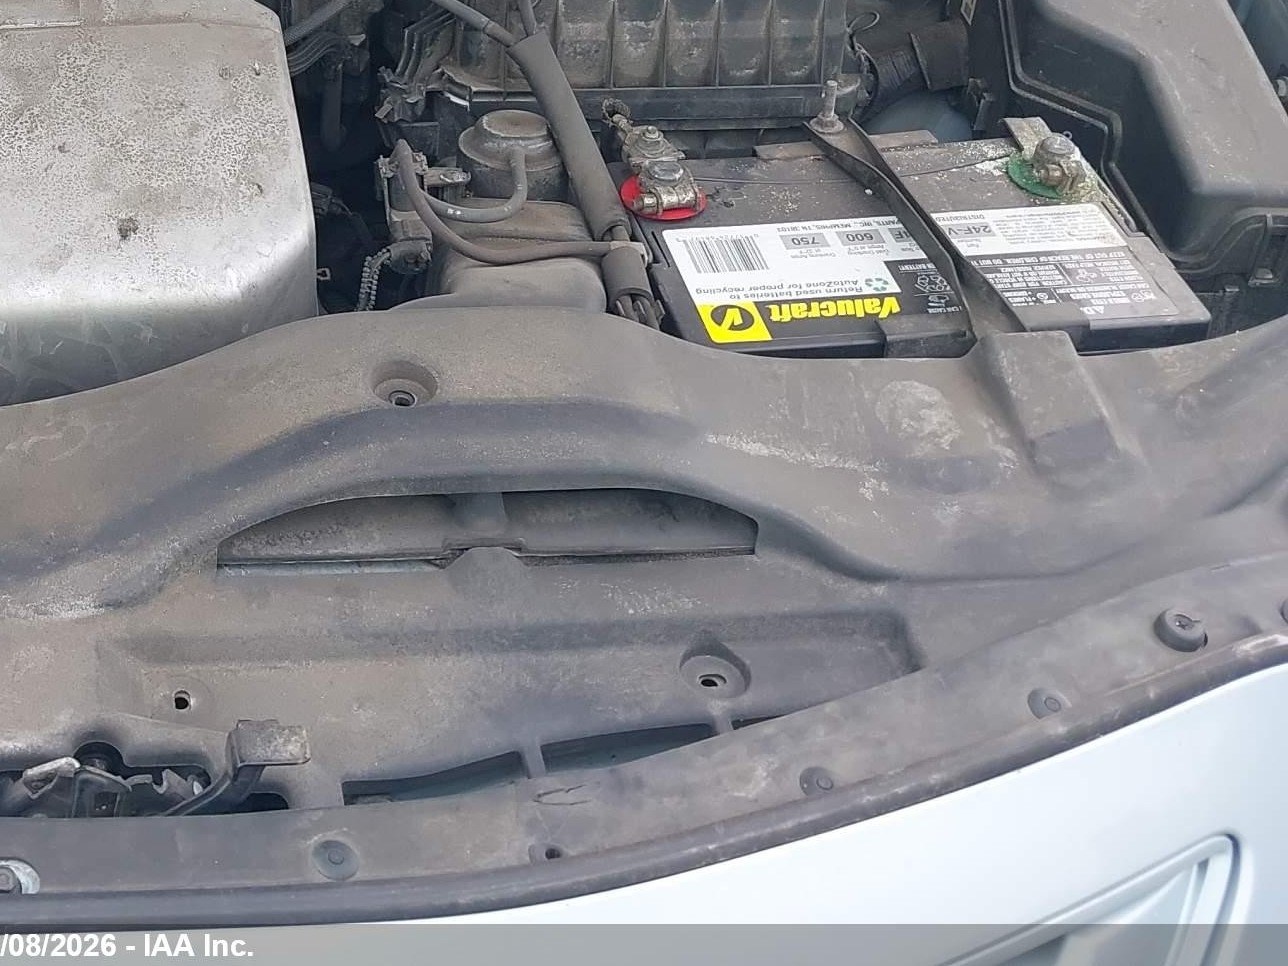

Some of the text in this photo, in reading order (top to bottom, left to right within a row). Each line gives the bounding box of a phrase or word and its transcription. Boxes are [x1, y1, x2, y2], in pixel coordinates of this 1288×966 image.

[790, 235, 818, 246] 750
[845, 232, 874, 242] 600
[748, 283, 784, 292] proper
[806, 279, 858, 289] AutoZone
[695, 286, 745, 296] recycling
[742, 291, 792, 300] batteries
[795, 289, 822, 297] used
[824, 286, 863, 295] Return
[766, 296, 901, 323] Valucraft
